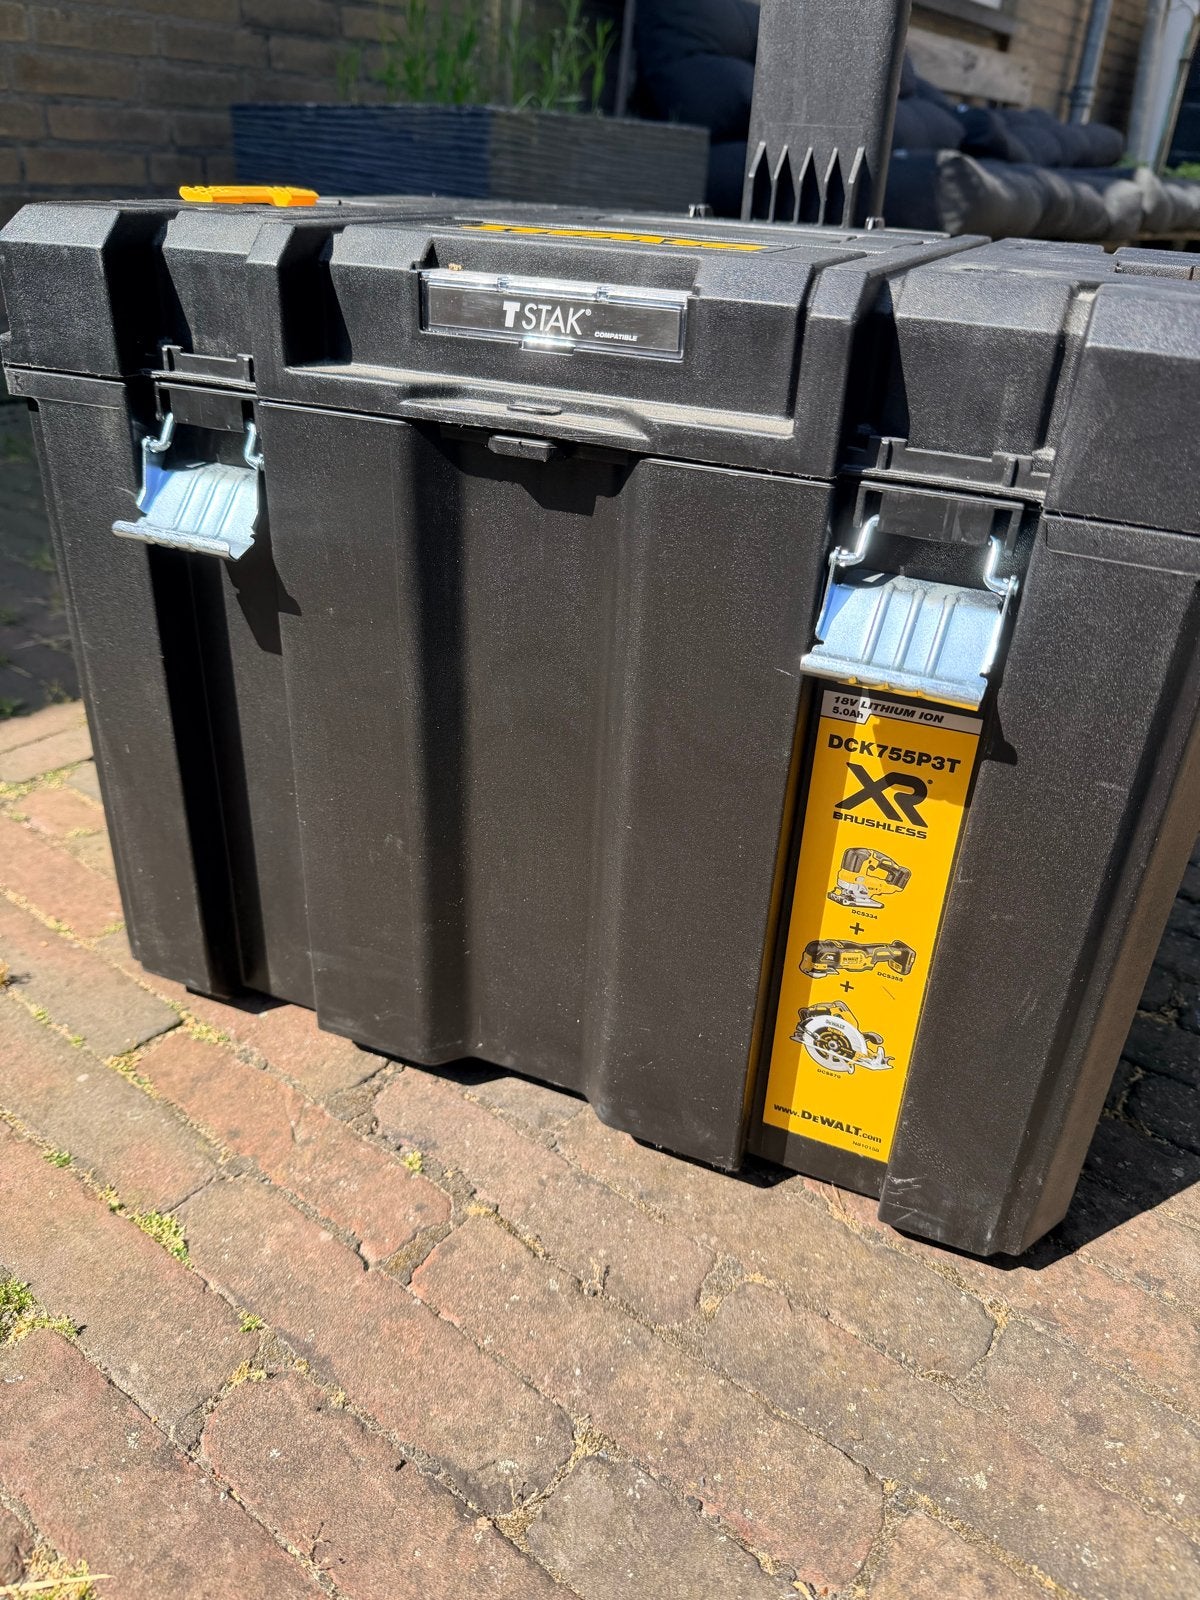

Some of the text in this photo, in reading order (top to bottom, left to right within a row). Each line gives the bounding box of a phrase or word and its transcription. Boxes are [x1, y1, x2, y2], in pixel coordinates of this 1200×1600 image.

[594, 331, 639, 342] COMPATIBLE
[832, 705, 864, 719] 5.0Ah
[833, 695, 945, 724] 18V LITHIUM ION
[828, 733, 961, 773] DCK755P3T
[832, 810, 928, 840] BRUSHLESS
[851, 908, 878, 920] DCS334
